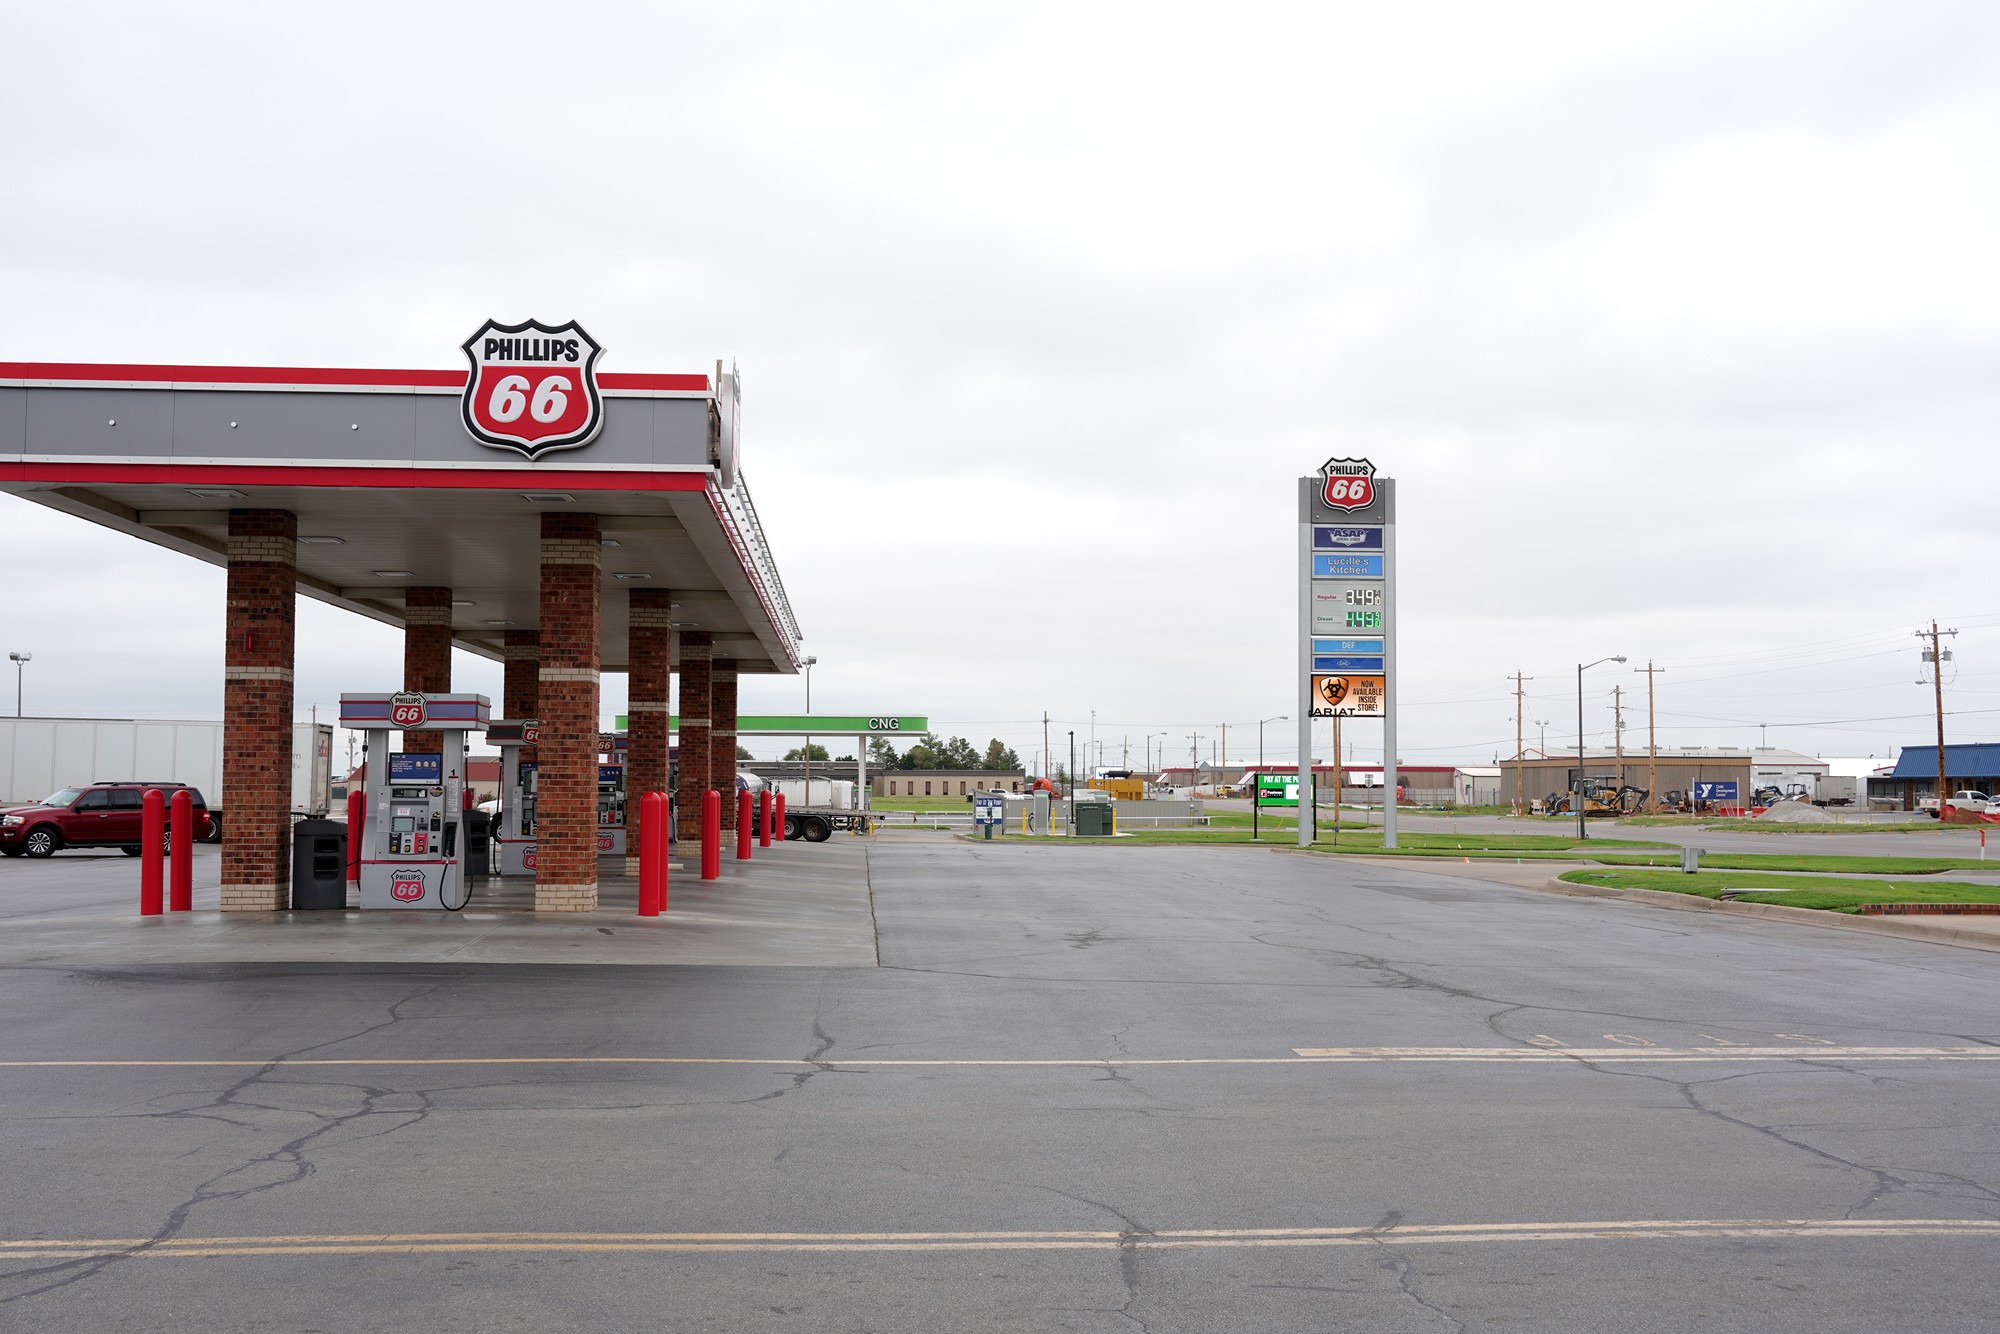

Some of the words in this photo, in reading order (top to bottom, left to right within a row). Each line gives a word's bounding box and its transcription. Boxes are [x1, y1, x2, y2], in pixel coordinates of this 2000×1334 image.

[484, 338, 580, 362] PHILLIPS
[489, 375, 572, 424] 66
[1330, 465, 1368, 475] PHILLIPS
[1331, 479, 1366, 500] 66
[1333, 528, 1365, 537] ASAP
[1328, 557, 1369, 565] Lucille's
[1330, 566, 1367, 574] Kitchen
[1346, 589, 1374, 605] 3.49
[1346, 611, 1374, 627] 4.49
[1353, 688, 1382, 696] AVAILABLE
[396, 707, 419, 721] 66
[868, 717, 899, 730] CNG
[396, 883, 419, 896] 66
